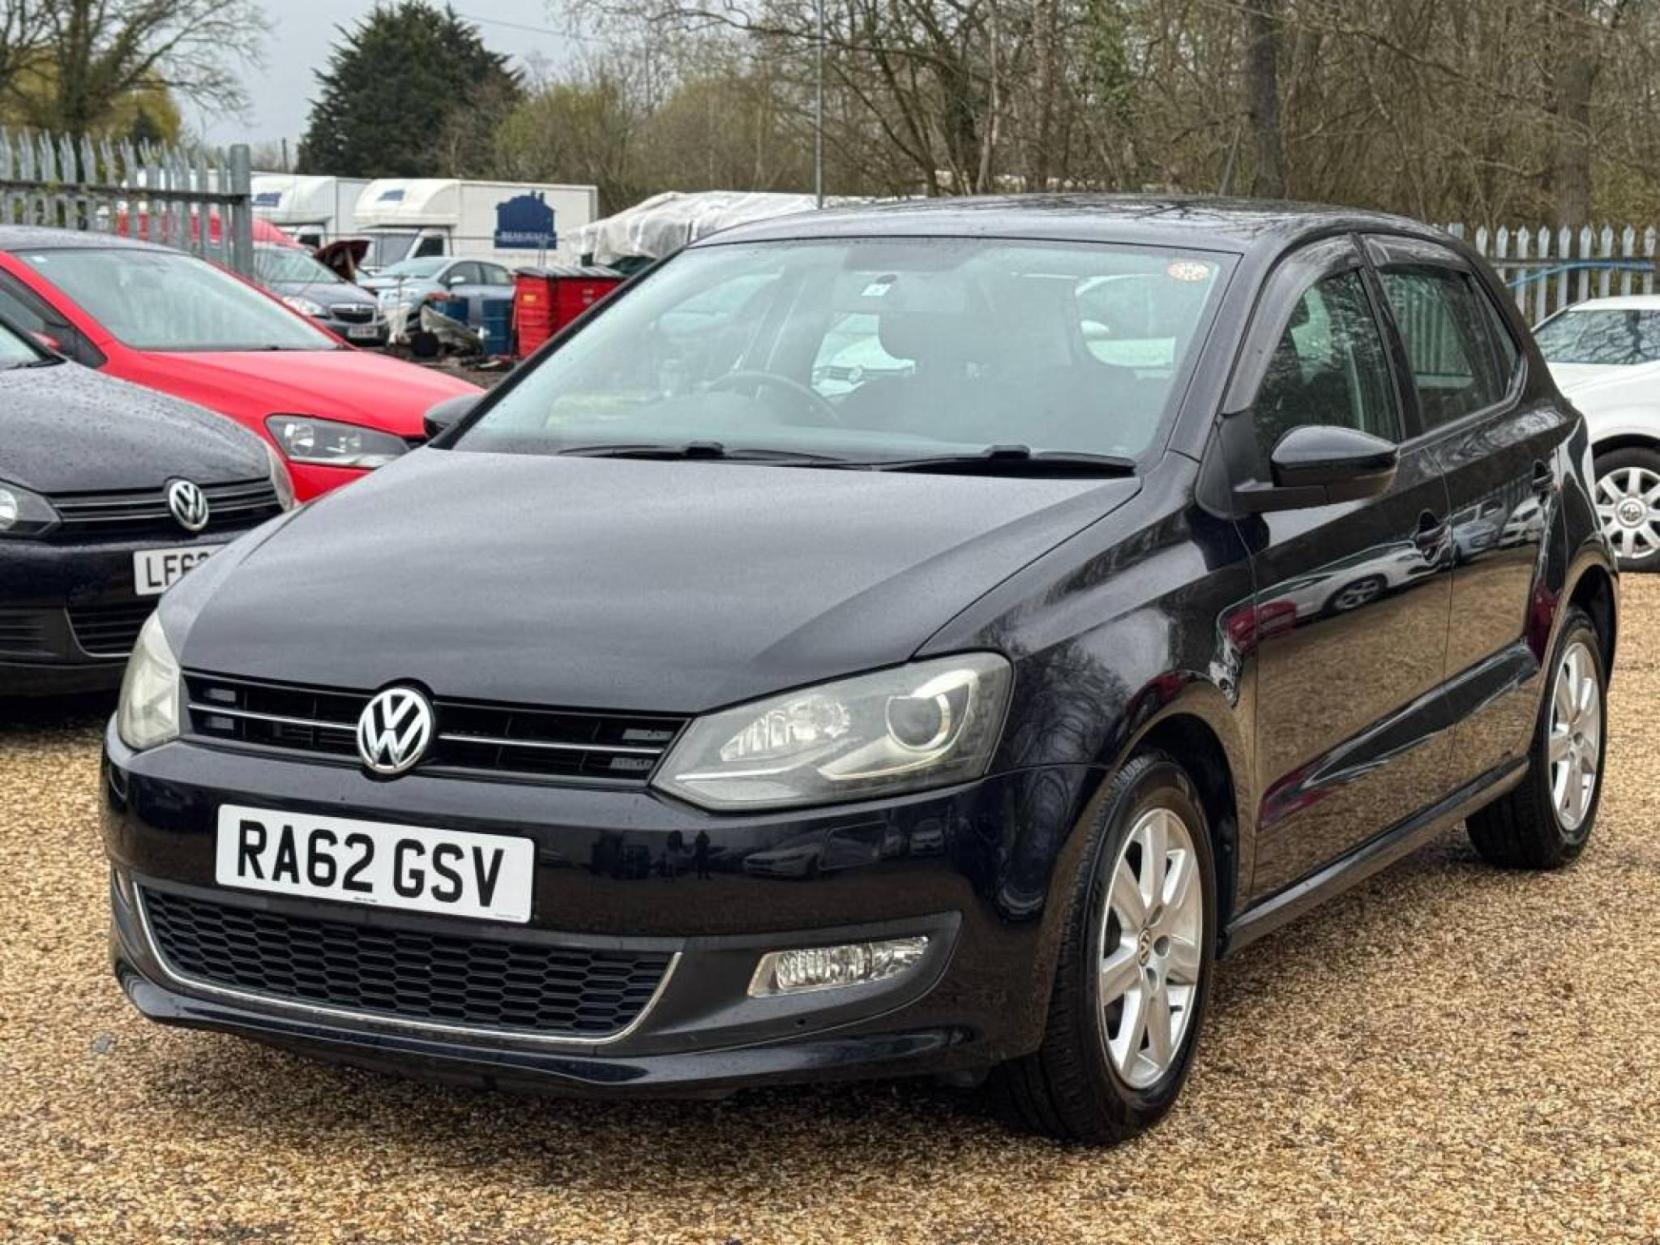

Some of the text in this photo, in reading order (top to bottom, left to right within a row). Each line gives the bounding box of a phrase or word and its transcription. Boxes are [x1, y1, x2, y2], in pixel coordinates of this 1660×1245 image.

[358, 688, 430, 773] VW
[238, 819, 504, 907] RA62 GSV
